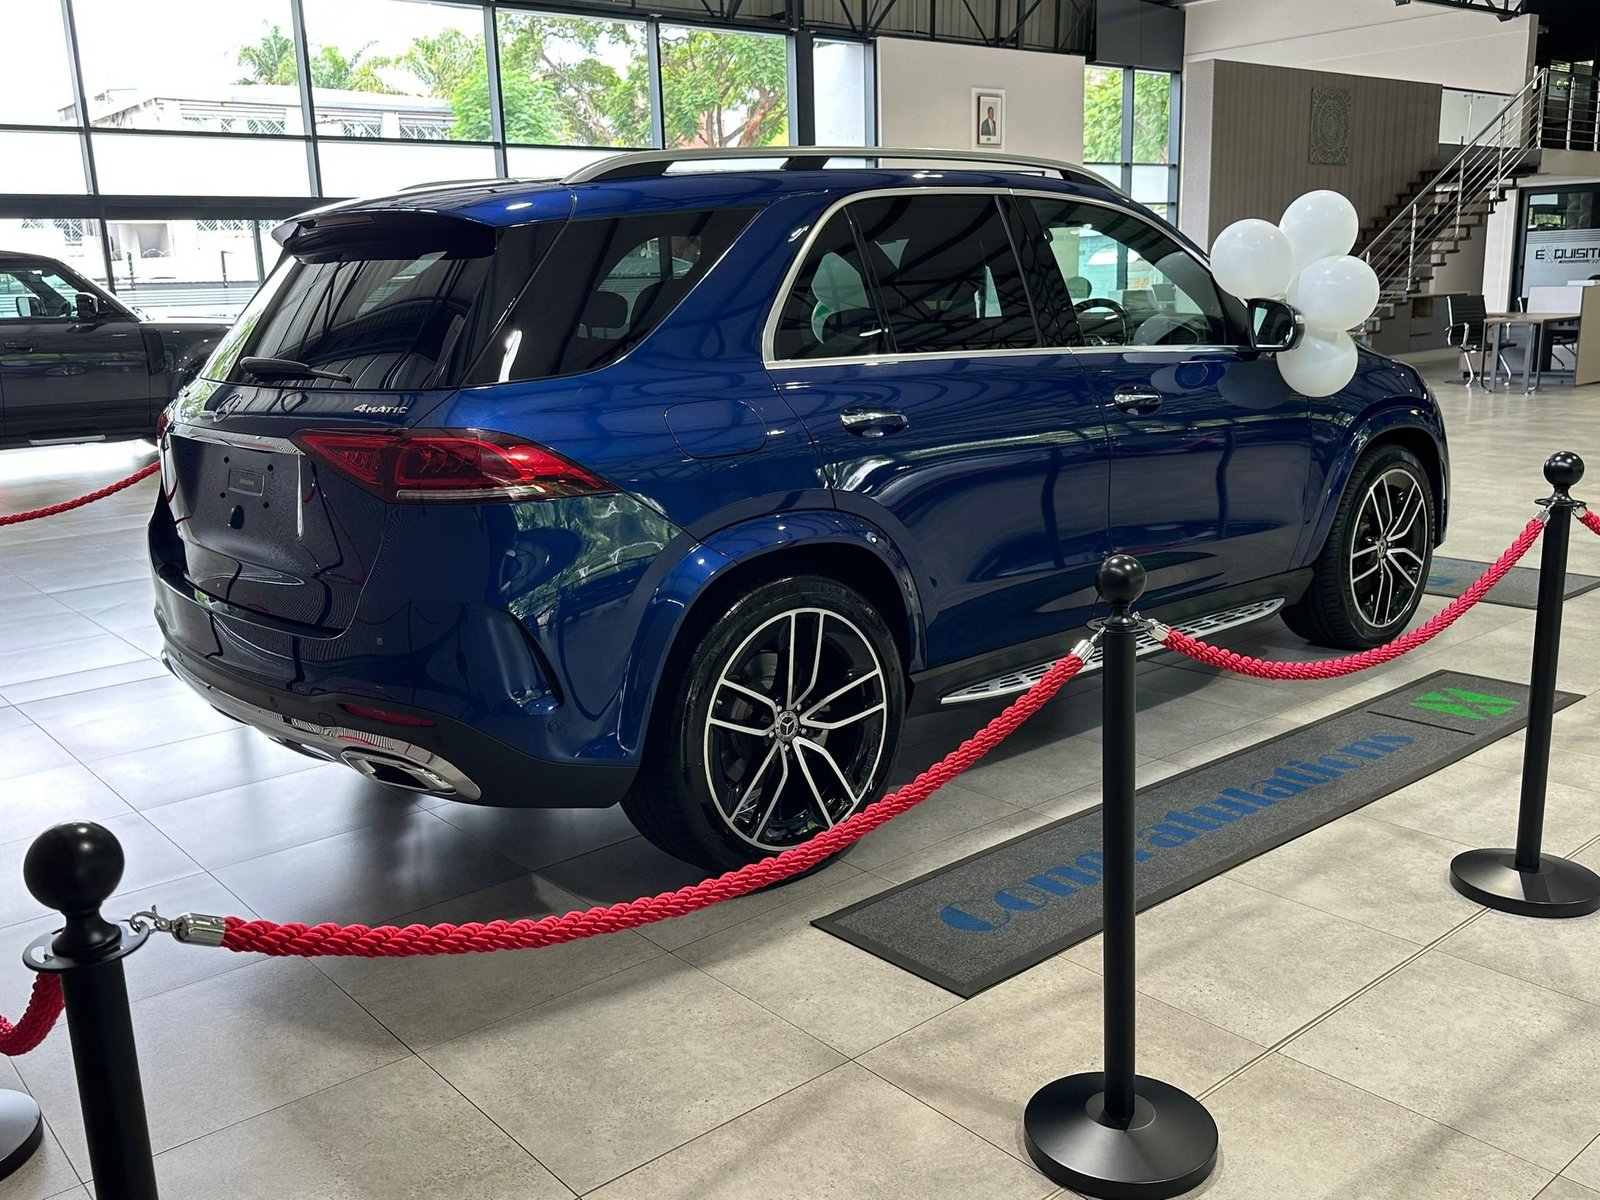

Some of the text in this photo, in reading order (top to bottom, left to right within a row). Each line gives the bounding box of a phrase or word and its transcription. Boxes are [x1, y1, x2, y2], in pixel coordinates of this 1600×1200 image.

[1535, 246, 1600, 263] EXQUISIT
[353, 403, 408, 414] 4MATIC
[939, 733, 1415, 932] Conatulations
